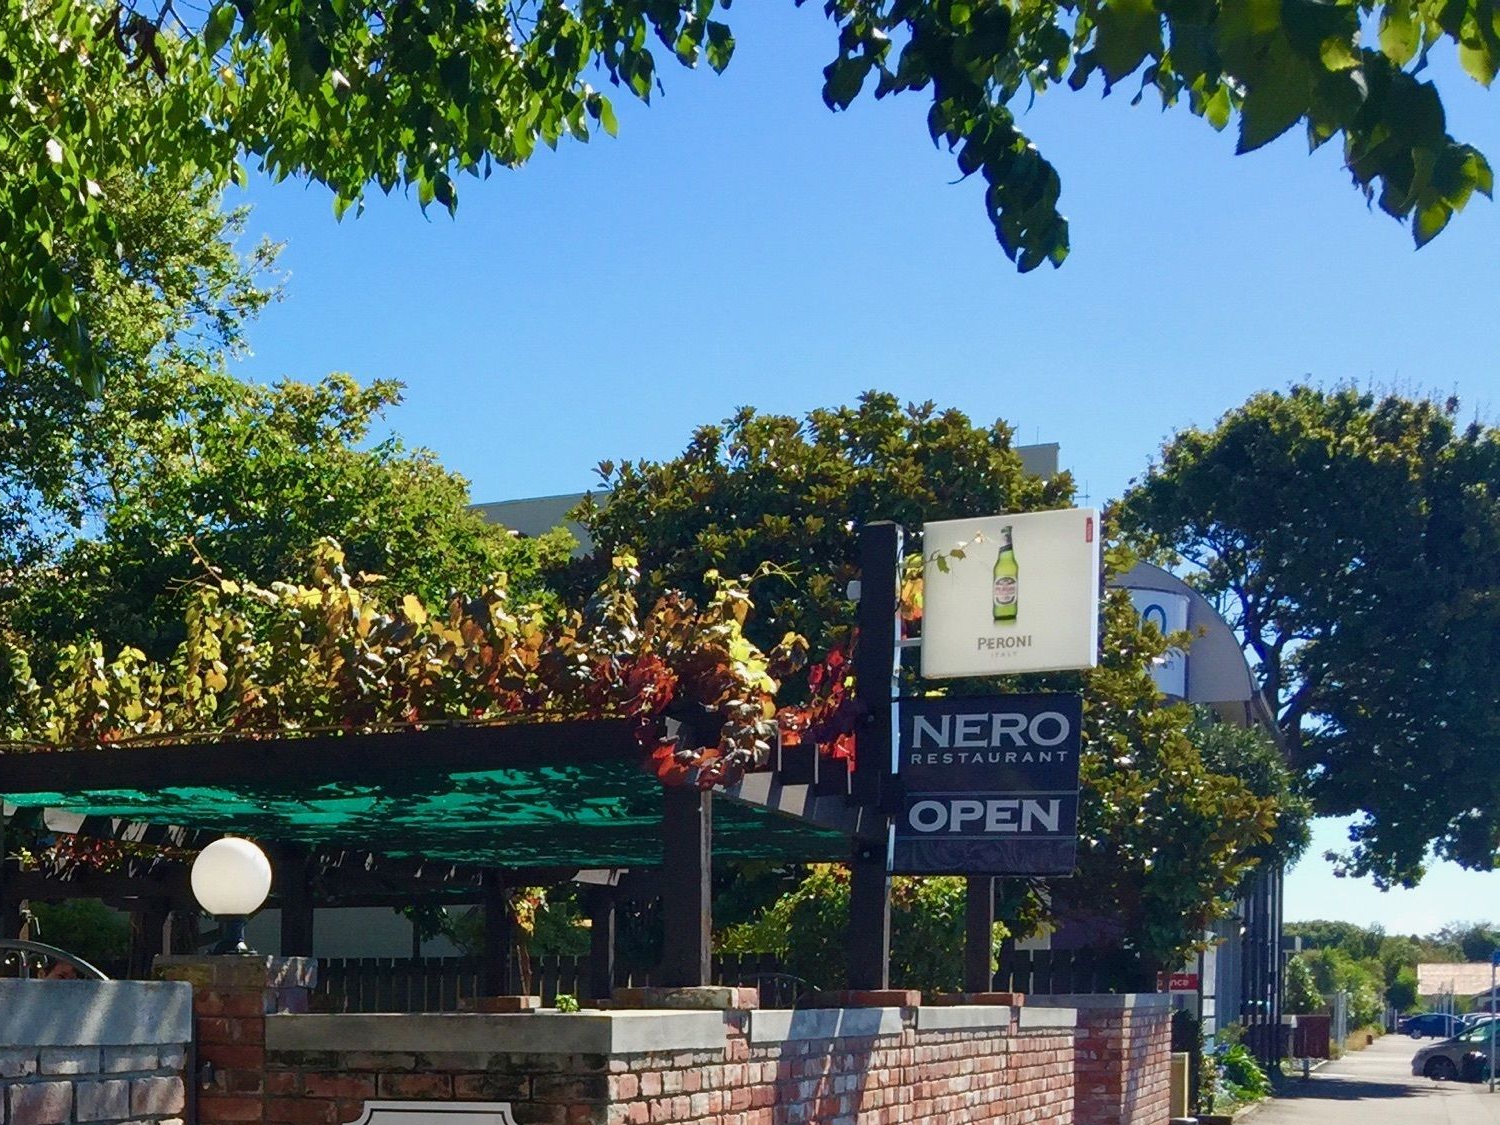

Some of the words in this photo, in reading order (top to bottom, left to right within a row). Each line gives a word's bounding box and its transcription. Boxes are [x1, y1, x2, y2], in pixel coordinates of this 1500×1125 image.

[977, 635, 1032, 650] PERONI
[911, 711, 1070, 748] NERO
[911, 751, 1068, 764] RESTAURANT
[908, 799, 1061, 833] OPEN
